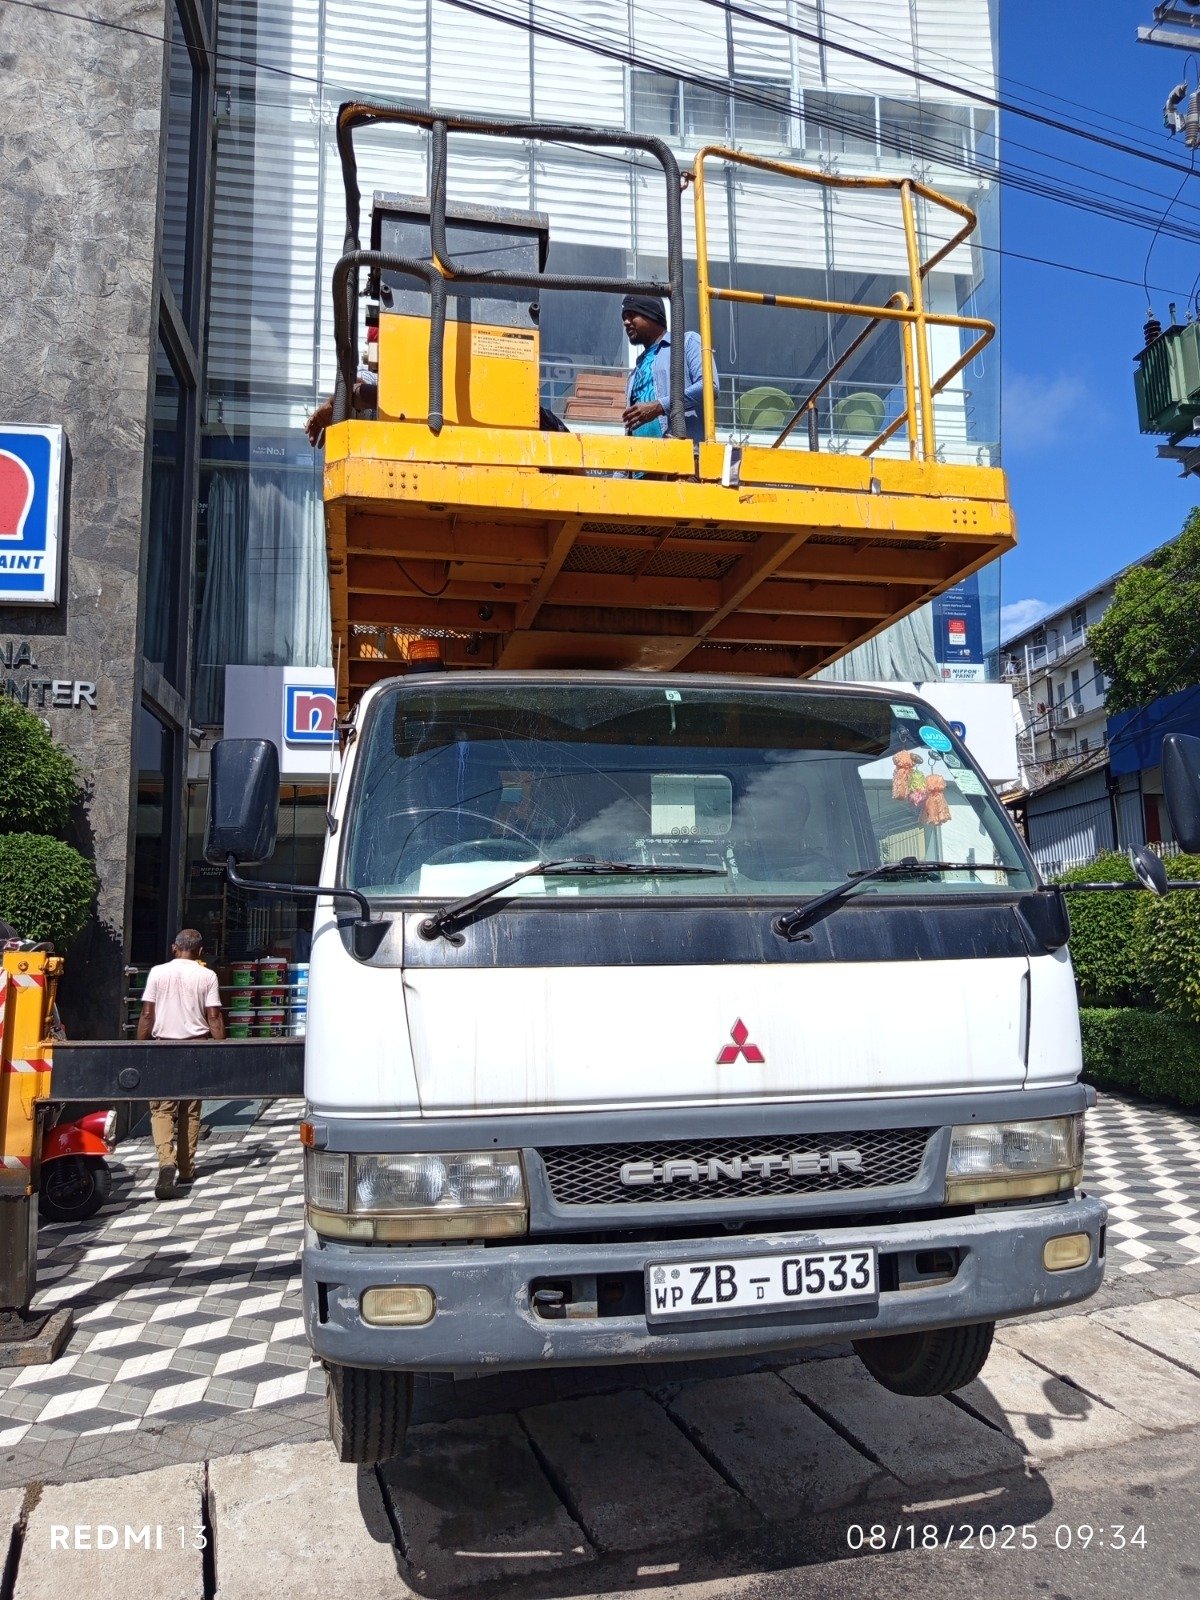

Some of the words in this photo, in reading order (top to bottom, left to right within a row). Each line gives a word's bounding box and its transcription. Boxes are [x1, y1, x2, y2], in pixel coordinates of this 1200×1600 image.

[266, 447, 285, 456] No.1
[619, 1150, 866, 1186] CANTER
[654, 1286, 684, 1309] WP
[689, 1264, 739, 1306] ZB
[781, 1252, 871, 1297] 0533
[756, 1286, 765, 1300] D
